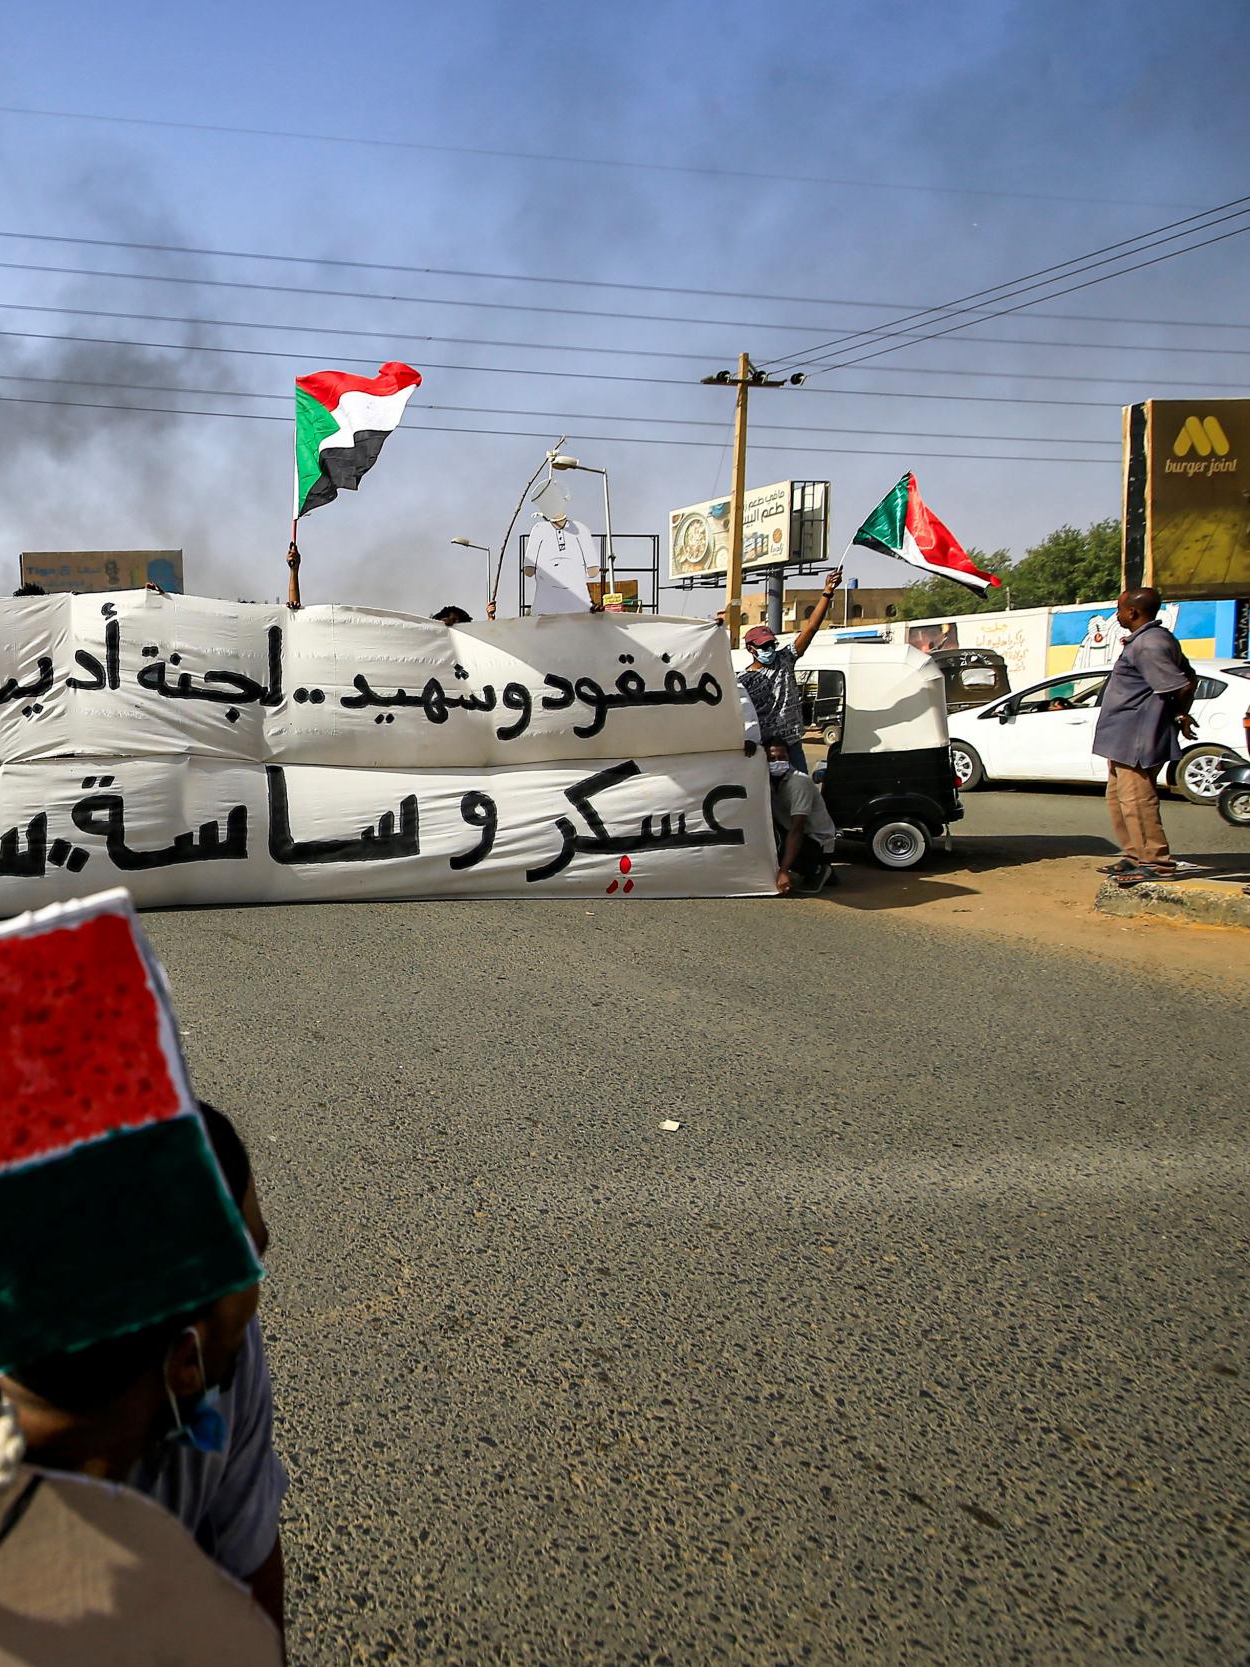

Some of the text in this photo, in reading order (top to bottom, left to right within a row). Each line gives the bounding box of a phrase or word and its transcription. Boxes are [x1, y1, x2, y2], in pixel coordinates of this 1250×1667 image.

[1165, 457, 1237, 478] burger joint
[761, 502, 785, 523] طعم
[136, 625, 288, 724] لجنة
[542, 652, 723, 739] مفقود
[526, 760, 748, 882] عسكر
